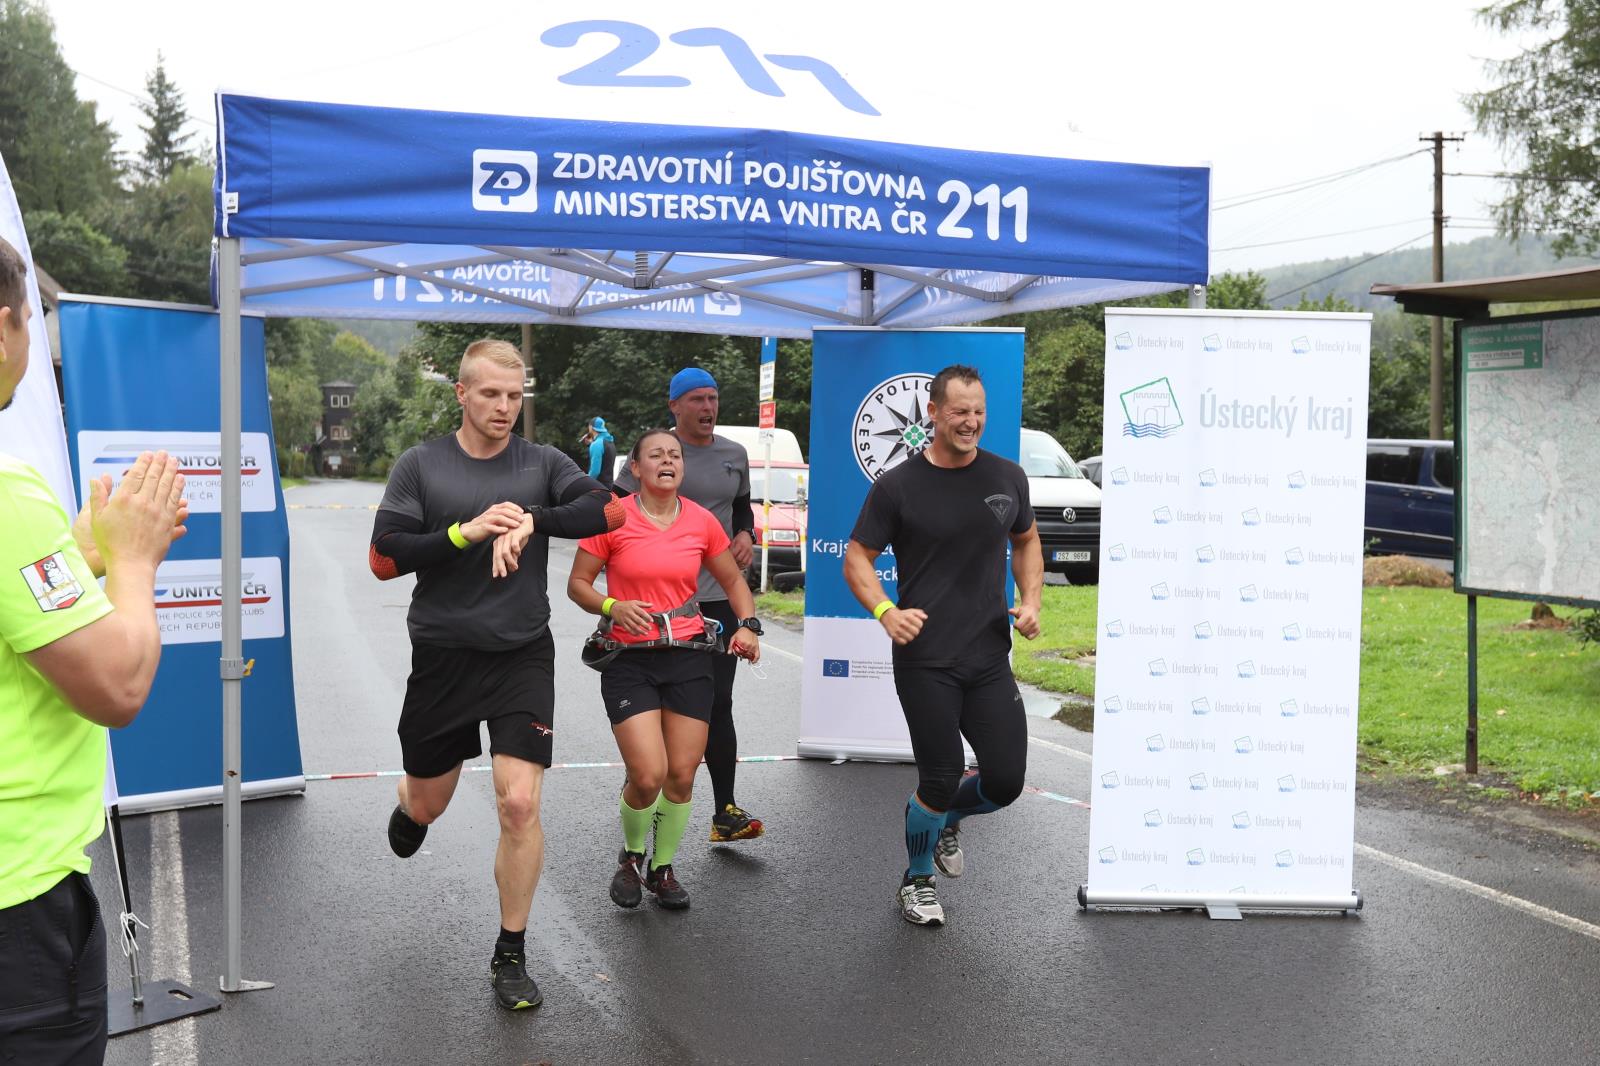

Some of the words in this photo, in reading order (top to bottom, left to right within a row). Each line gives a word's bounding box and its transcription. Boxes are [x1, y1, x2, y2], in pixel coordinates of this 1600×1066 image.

[540, 19, 882, 117] 211
[552, 150, 734, 186] ZDRAVOTNÍ
[744, 158, 927, 201] POJIŠŤOVNA
[553, 189, 771, 223] MINISTERSTVA
[777, 199, 882, 232] VNITRA
[890, 201, 928, 235] ČR
[936, 179, 1029, 243] 211
[875, 379, 932, 405] POLIC
[1200, 387, 1298, 438] Ústecký
[1307, 396, 1353, 440] kraj
[172, 585, 222, 598] UNITO
[243, 582, 267, 595] ČR
[158, 612, 171, 621] HE
[173, 611, 202, 620] POLICE
[159, 623, 180, 632] ECH
[186, 621, 222, 631] REPUB
